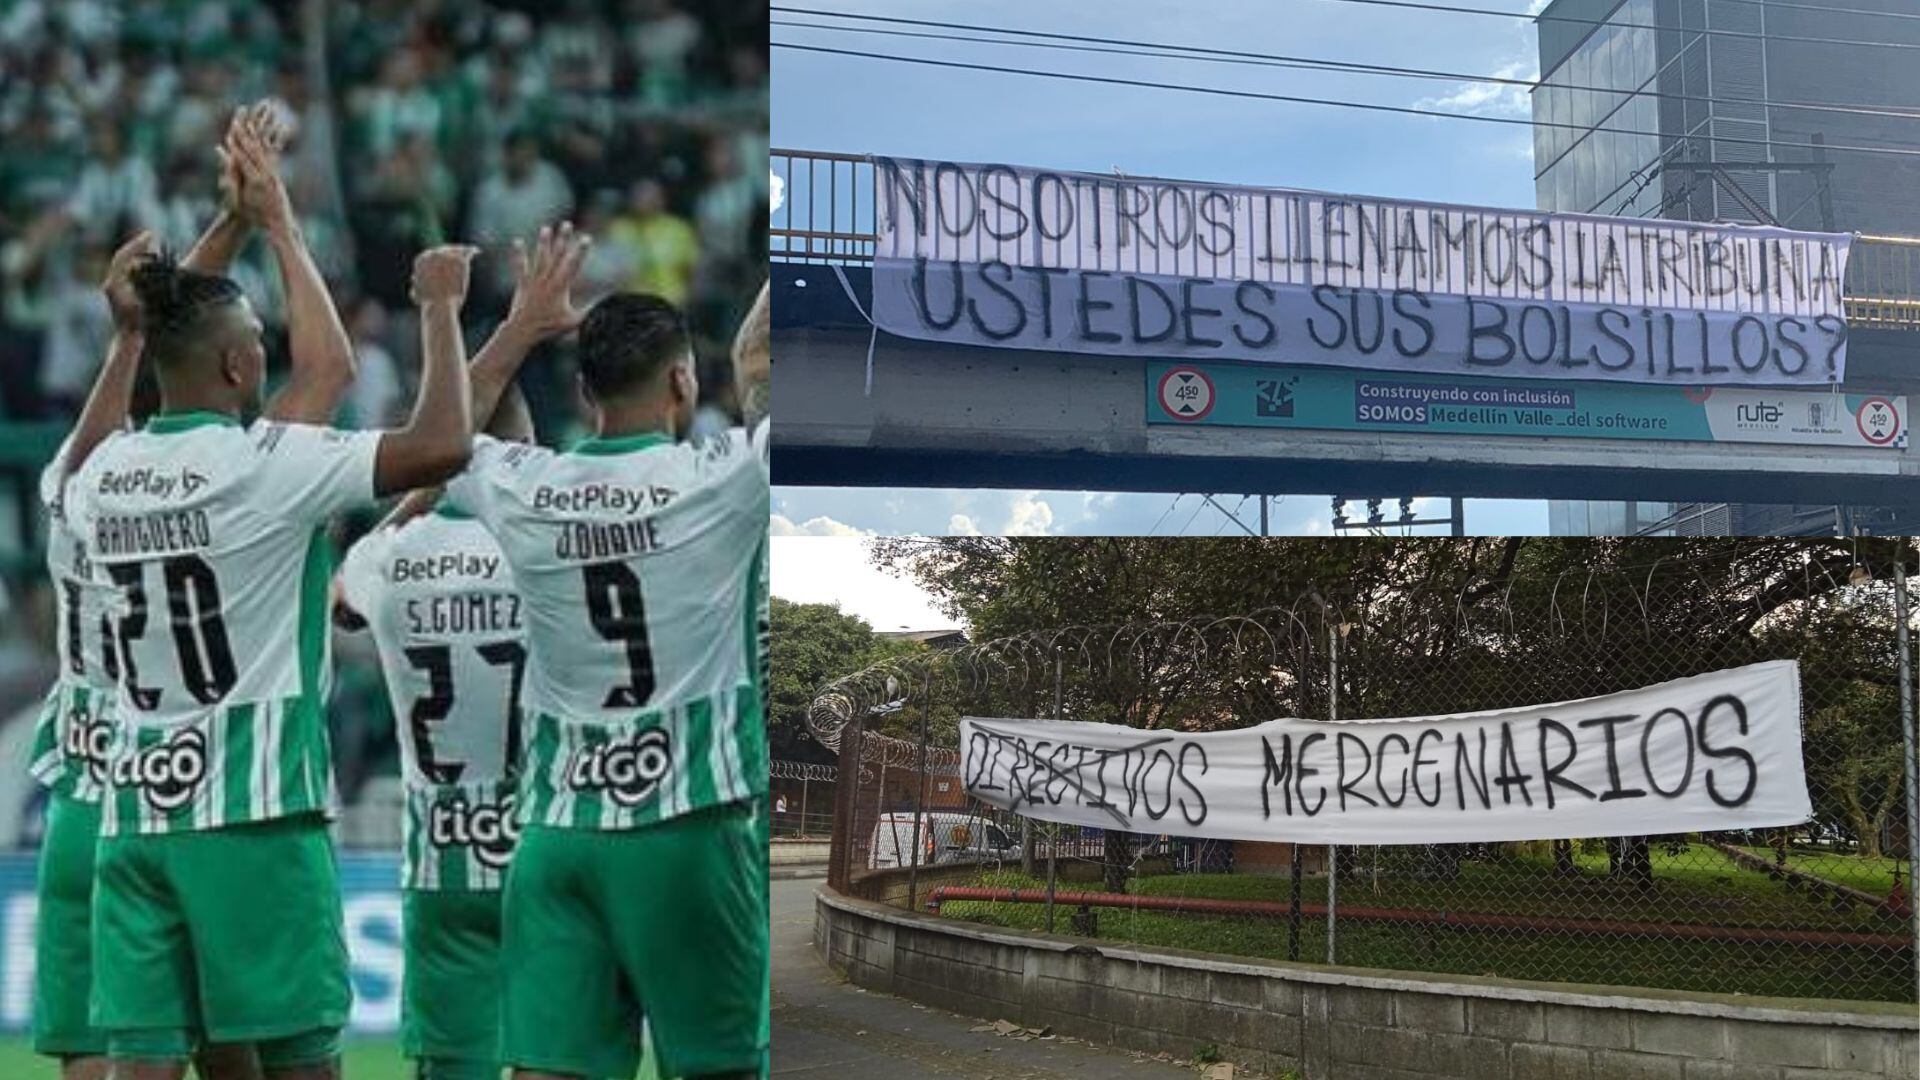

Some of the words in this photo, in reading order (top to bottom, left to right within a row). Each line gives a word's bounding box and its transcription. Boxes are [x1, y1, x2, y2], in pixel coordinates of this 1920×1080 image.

[876, 156, 1236, 257] NOSOTROS
[1257, 194, 1555, 291] LLENAMOS
[910, 257, 1276, 349] USTEDES
[1306, 284, 1434, 358] SUS
[1358, 404, 1426, 422] SOMOS
[1431, 407, 1508, 425] Medellín
[1595, 411, 1668, 430] software
[1359, 383, 1469, 402] Construyendo
[1472, 390, 1500, 402] con
[1502, 388, 1571, 405] inclusión
[98, 467, 176, 498] BetPlay
[534, 484, 644, 514] BetPlay
[392, 552, 500, 583] BetPlay
[105, 554, 238, 711] 20
[407, 593, 523, 635] S.GOMEZ
[582, 559, 657, 708] 9
[404, 639, 528, 786] 27
[1261, 694, 1758, 821] MERCENARIOS
